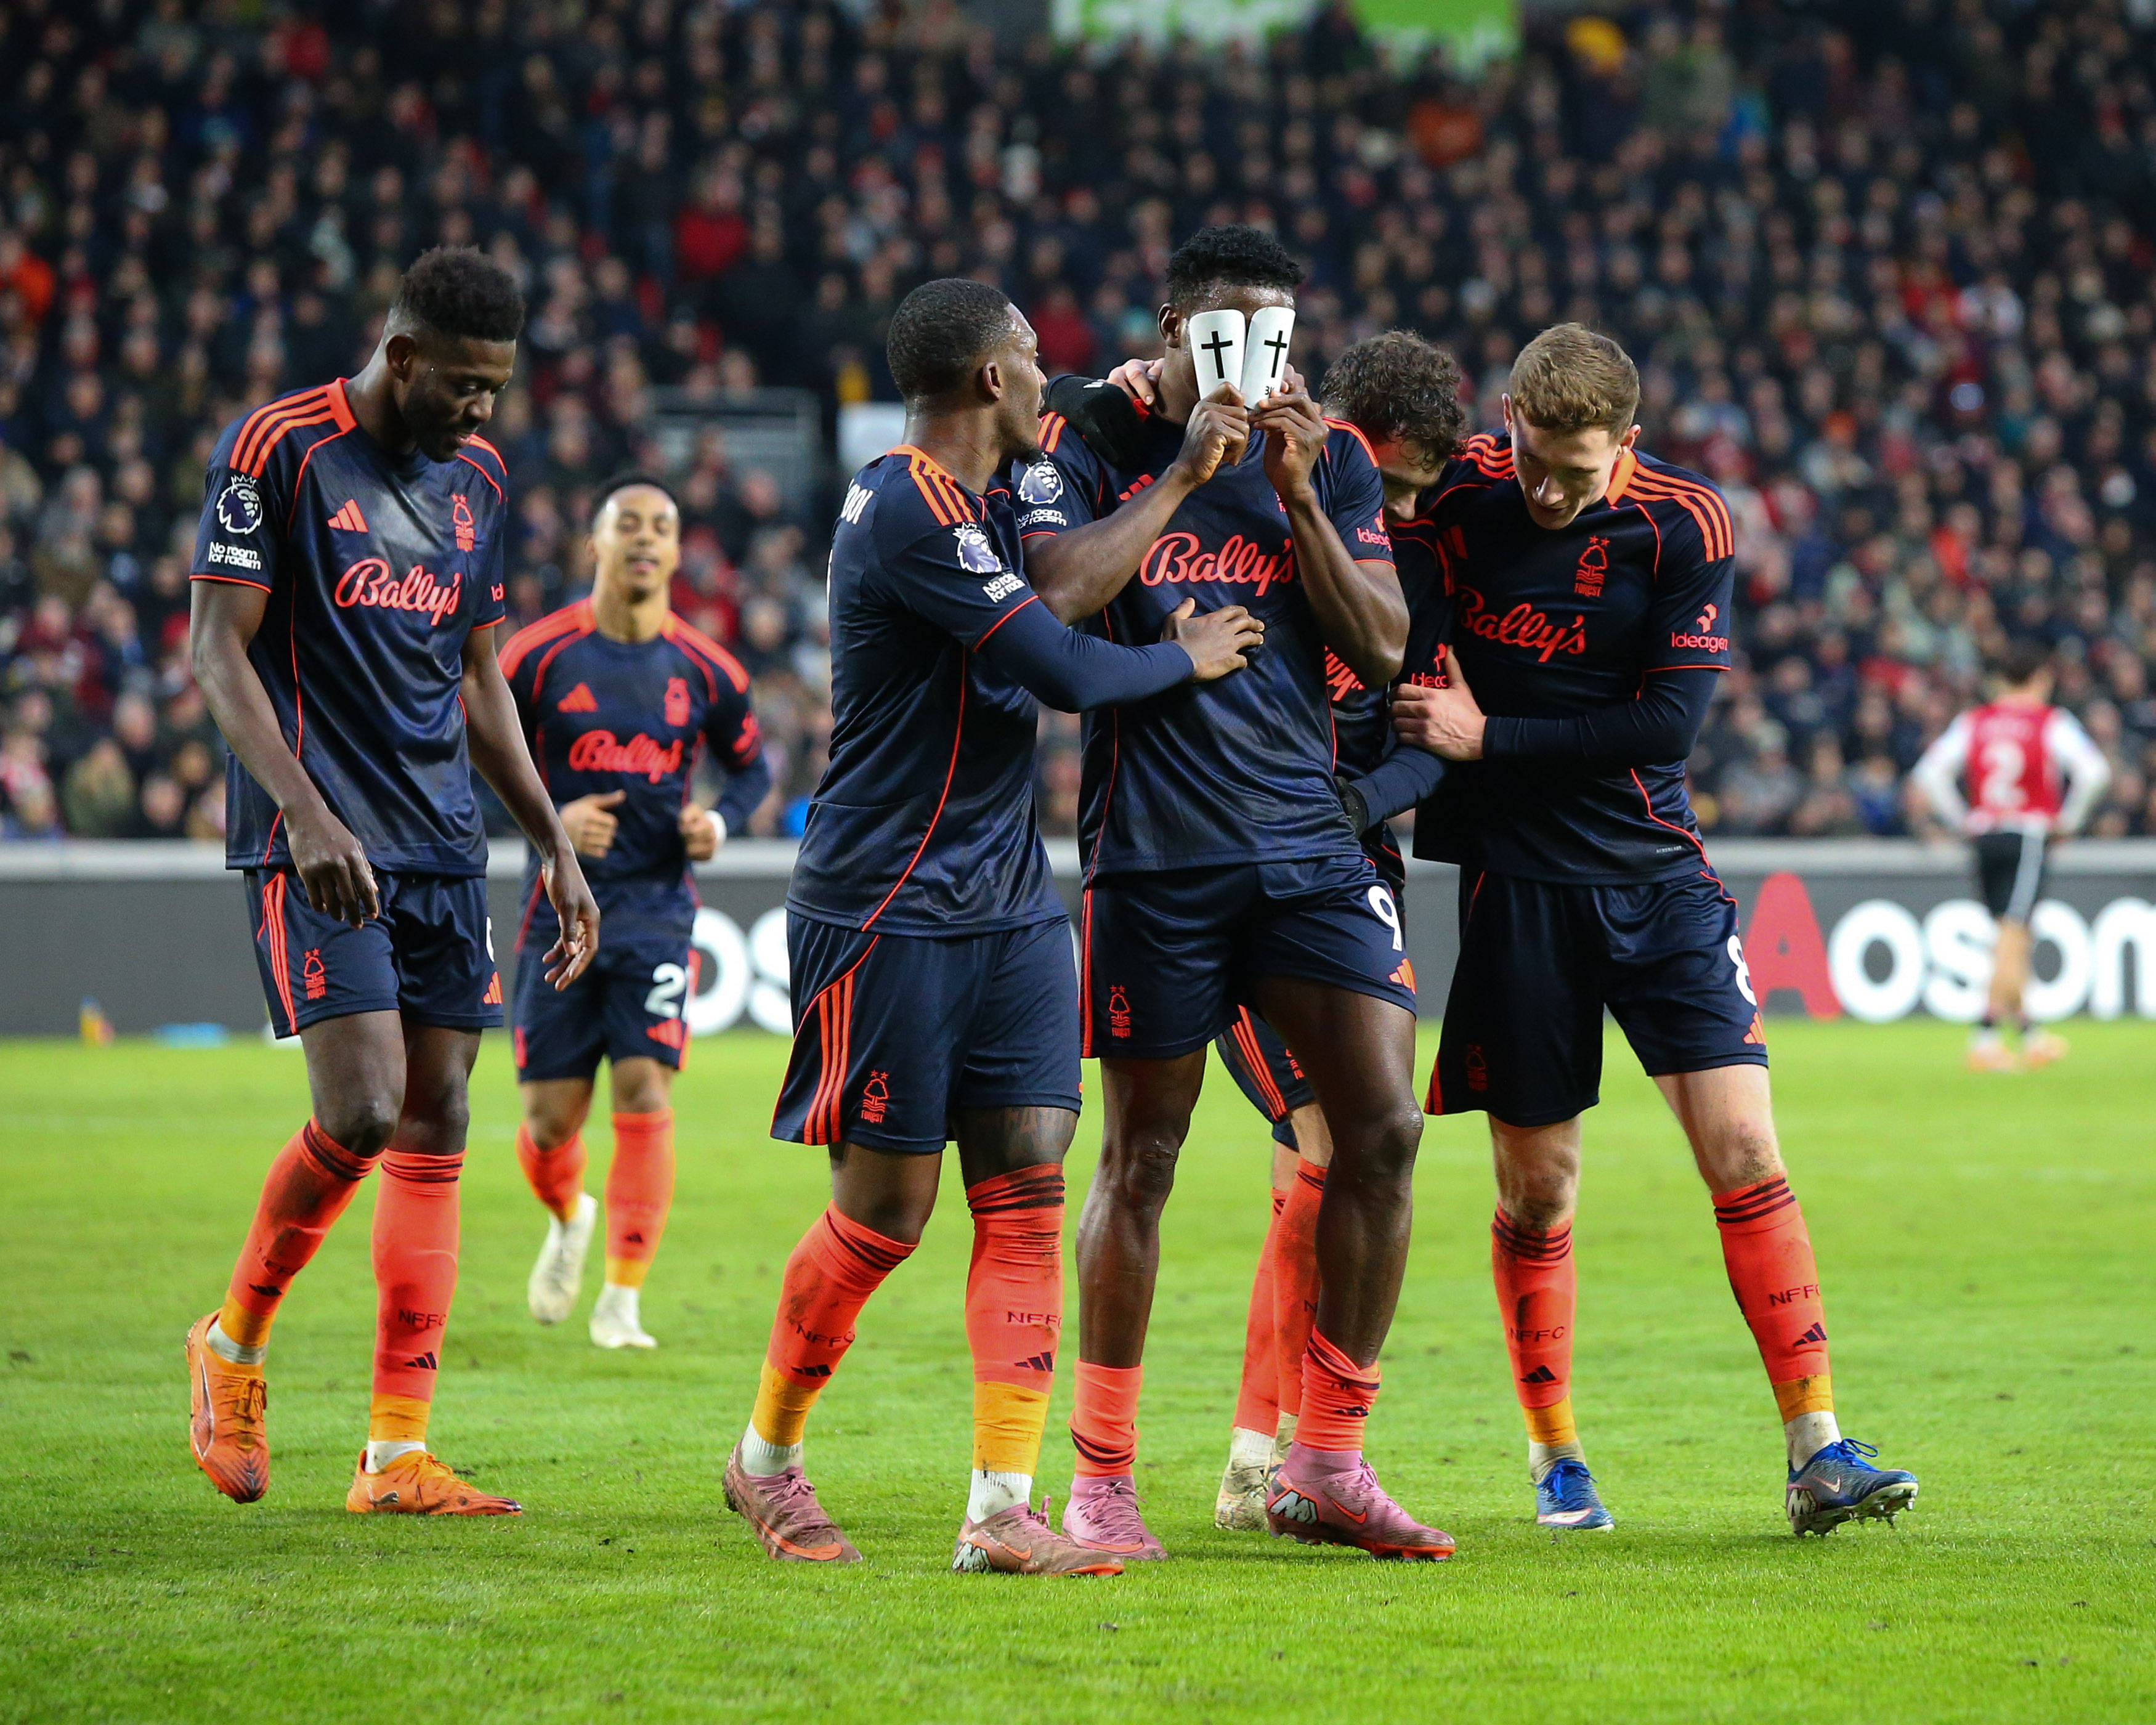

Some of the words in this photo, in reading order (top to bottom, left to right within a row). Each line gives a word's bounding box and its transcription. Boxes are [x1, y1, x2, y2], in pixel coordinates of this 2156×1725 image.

[1029, 516, 1067, 526] racism
[1031, 509, 1062, 519] room
[209, 542, 225, 554] No
[227, 546, 257, 559] room
[224, 554, 261, 570] racism
[1140, 532, 1293, 596] Bally's
[334, 558, 461, 626] Bally's
[1671, 632, 1728, 653] Ideagen
[1979, 739, 2028, 808] 2
[1368, 885, 1403, 952] 9
